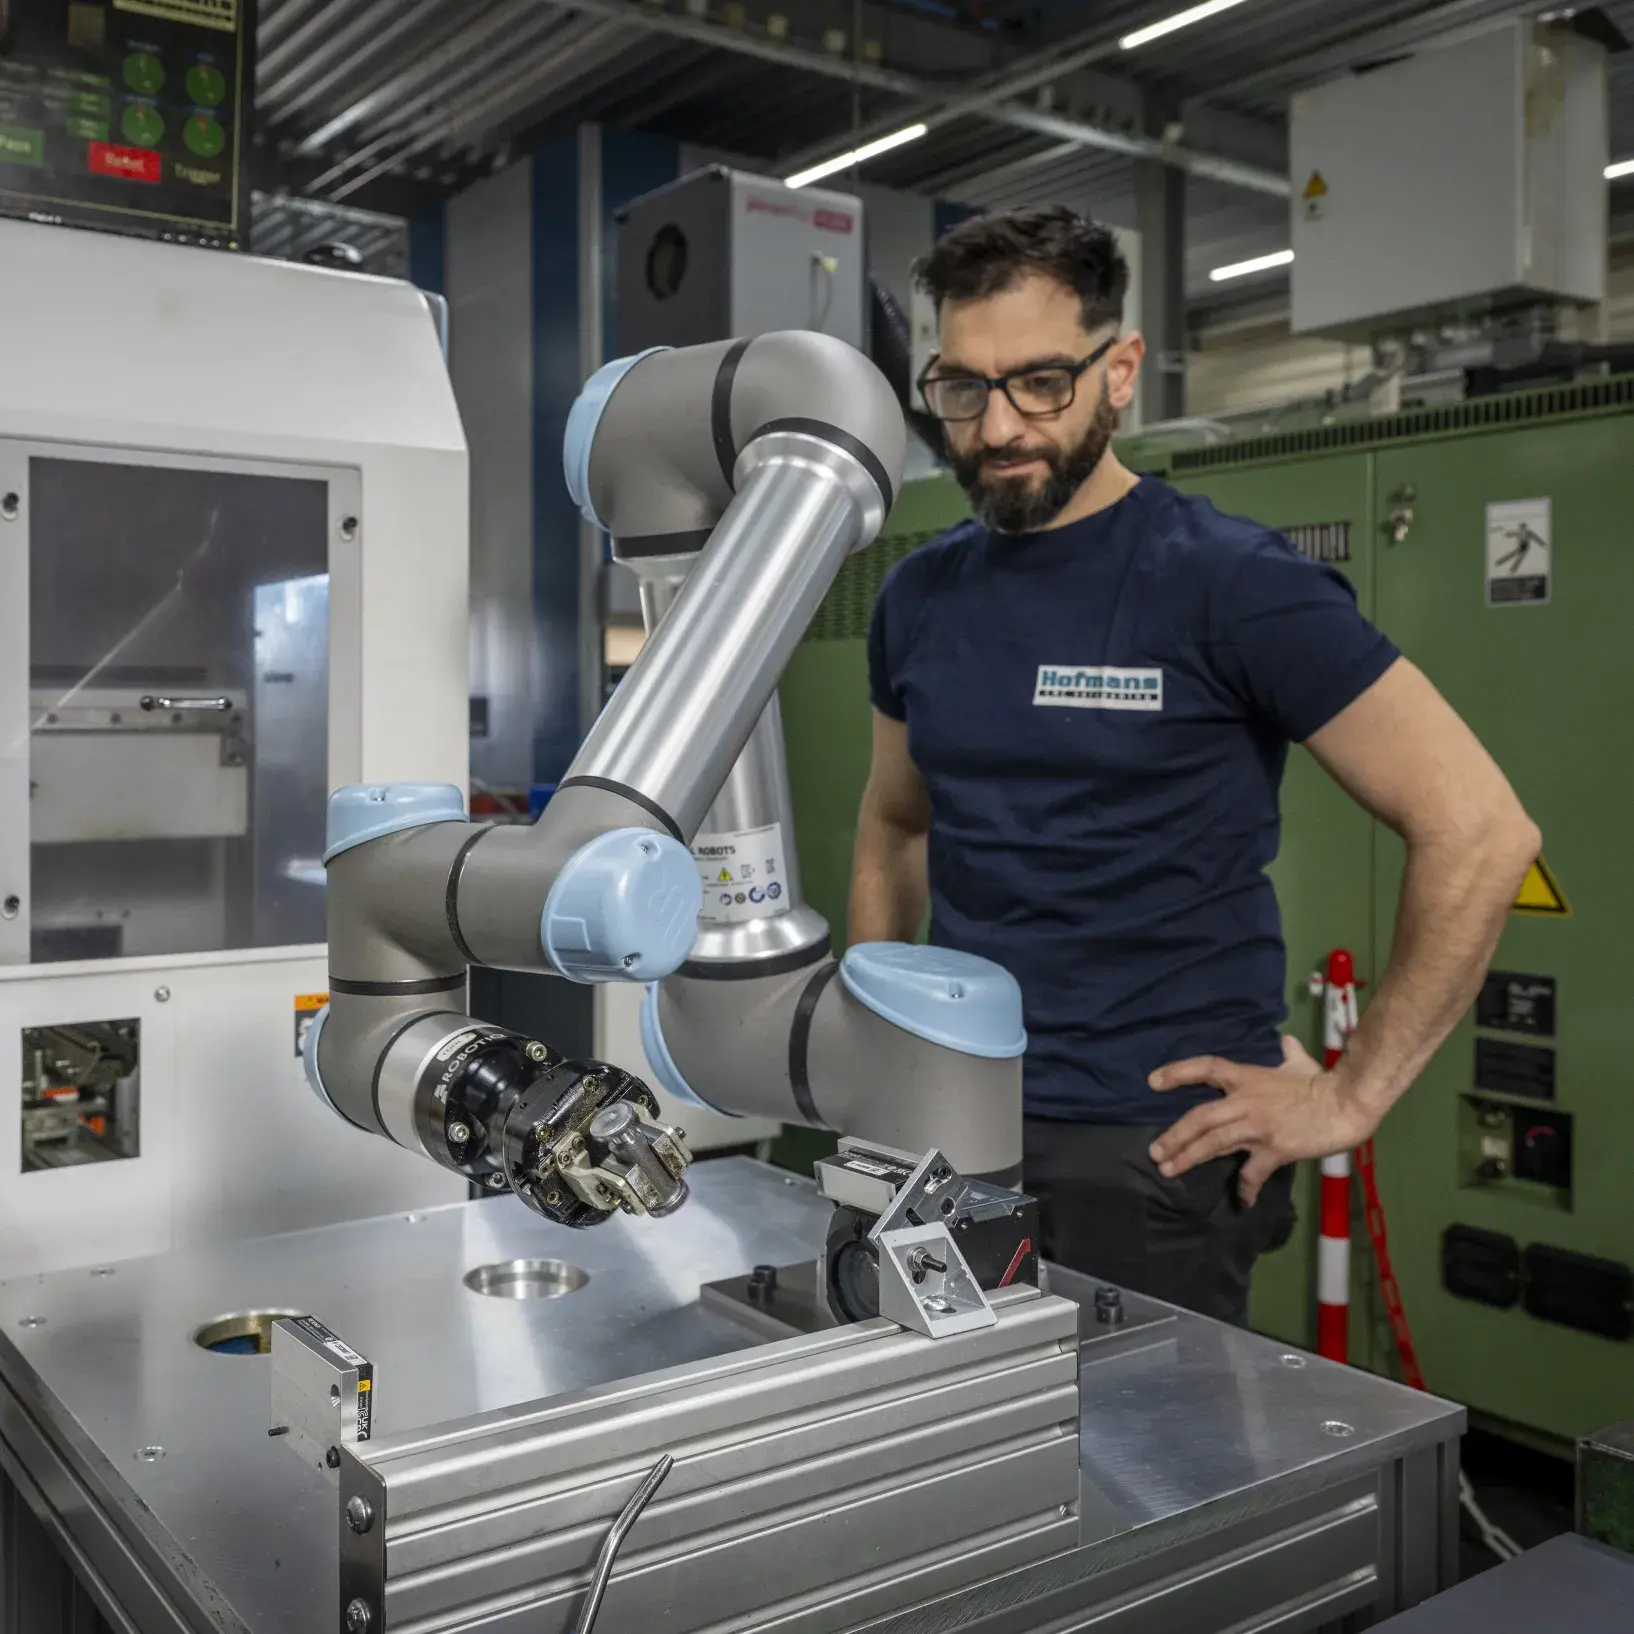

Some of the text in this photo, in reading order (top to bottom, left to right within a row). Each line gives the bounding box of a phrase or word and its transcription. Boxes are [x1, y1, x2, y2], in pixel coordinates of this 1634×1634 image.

[1042, 670, 1158, 690] Hofmans
[698, 845, 736, 856] ROBOTS
[441, 1033, 507, 1083] ROBOTIQ
